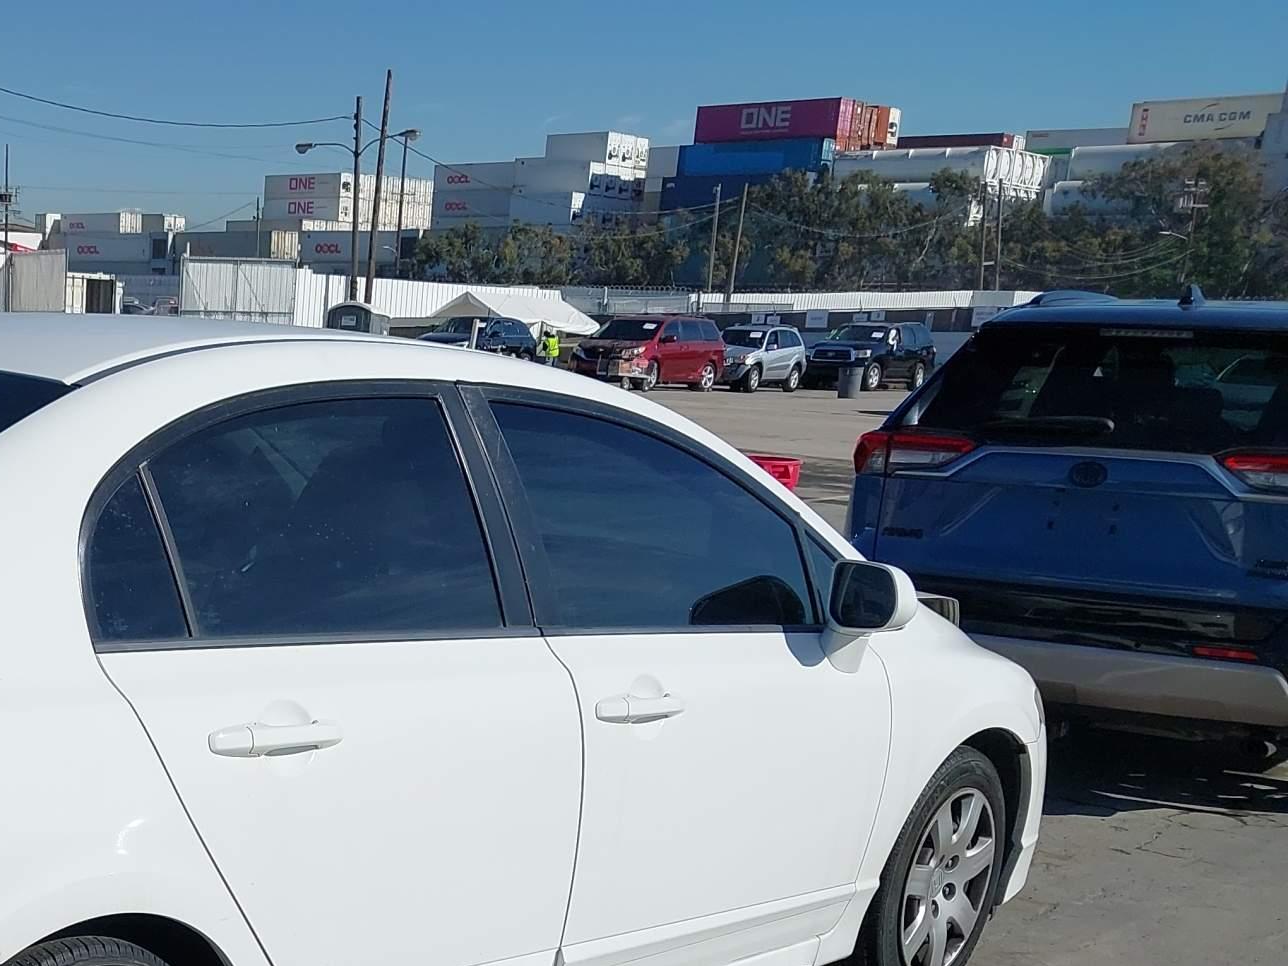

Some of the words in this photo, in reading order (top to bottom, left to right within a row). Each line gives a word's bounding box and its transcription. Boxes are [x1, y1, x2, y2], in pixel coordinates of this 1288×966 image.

[740, 105, 792, 129] ONE
[1183, 114, 1214, 124] CMA
[1218, 111, 1252, 122] CGM
[289, 177, 316, 191] ONE
[288, 202, 315, 215] ONE
[315, 243, 342, 254] OOCL
